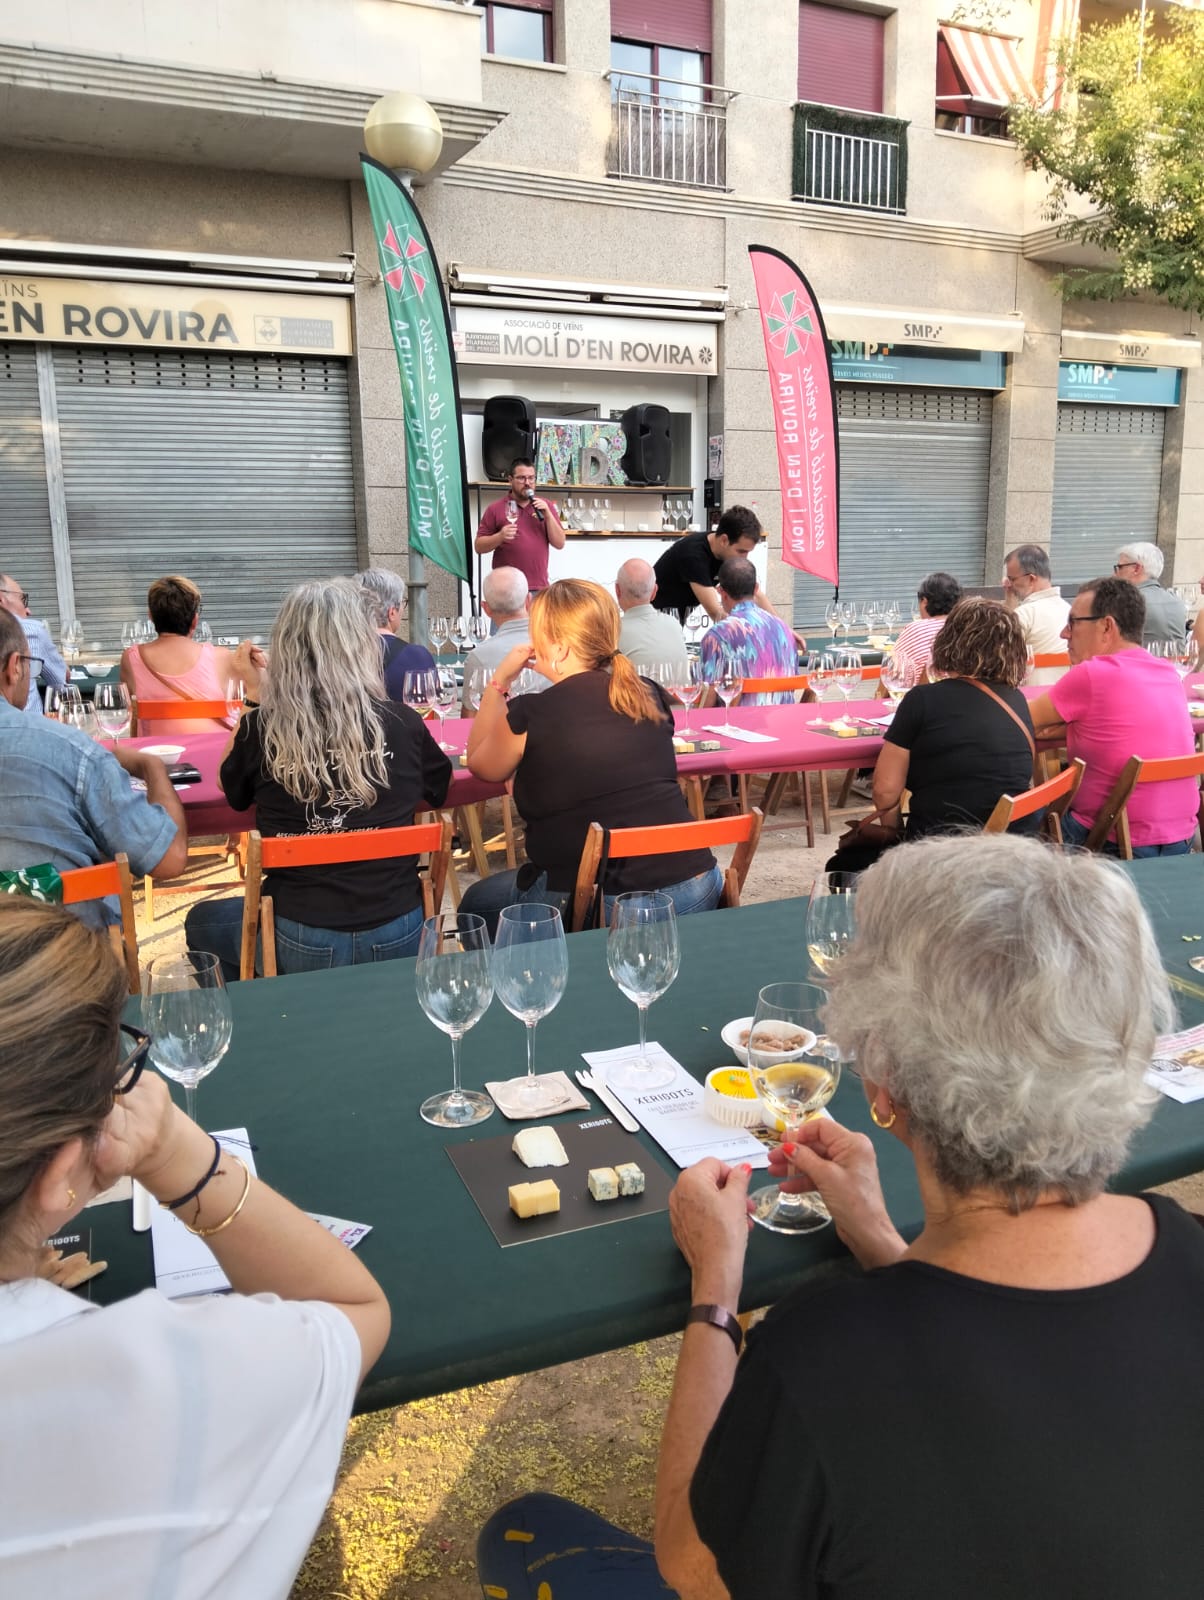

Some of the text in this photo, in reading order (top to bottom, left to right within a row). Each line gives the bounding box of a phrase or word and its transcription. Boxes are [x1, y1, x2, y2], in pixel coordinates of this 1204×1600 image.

[0, 279, 39, 298] ÏNS
[62, 303, 240, 344] ROVIRA
[504, 319, 550, 329] ASSOCIACIÓ
[552, 321, 561, 330] DE
[904, 323, 933, 337] SMP
[503, 331, 694, 365] MOLÍ D'EN ROVIRA
[831, 340, 878, 361] SMP
[1120, 344, 1141, 356] SMP
[1067, 363, 1105, 384] SMP
